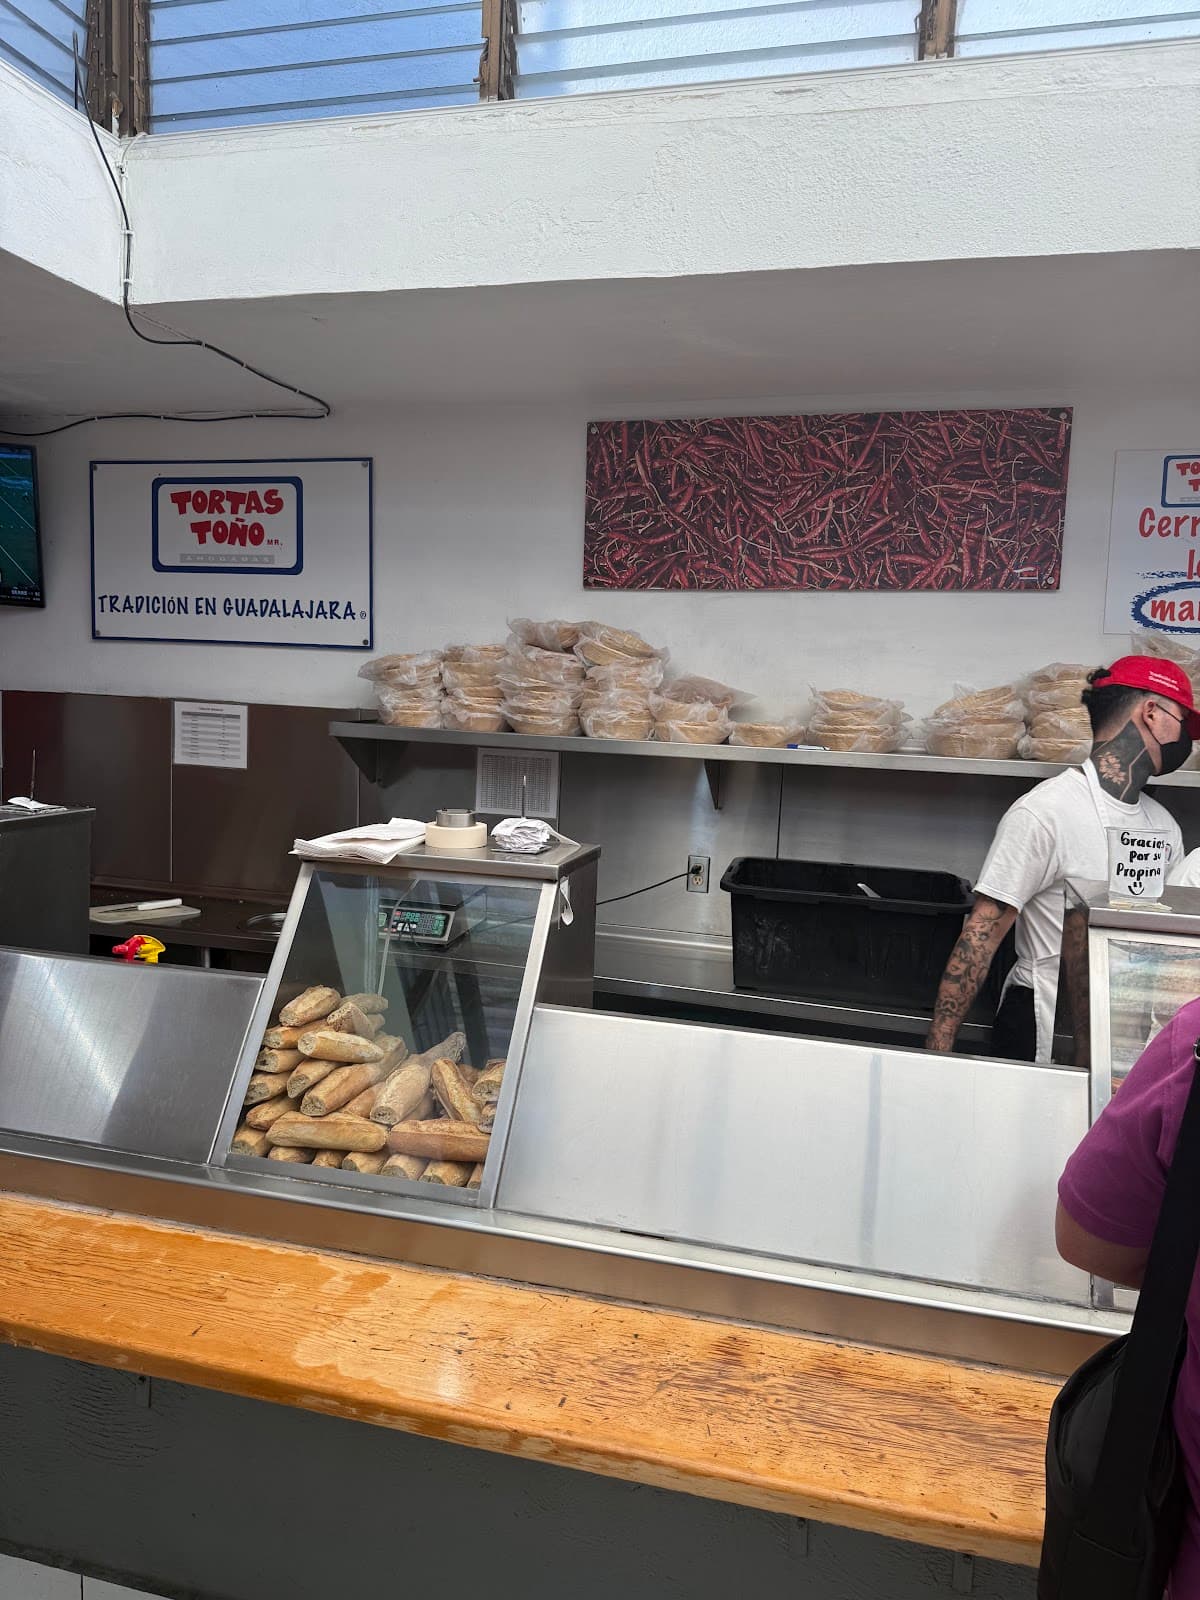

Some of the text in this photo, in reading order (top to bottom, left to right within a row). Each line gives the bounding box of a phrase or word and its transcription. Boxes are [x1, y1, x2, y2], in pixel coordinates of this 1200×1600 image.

[170, 489, 284, 515] TORTAS
[190, 518, 265, 547] TOÑO
[98, 595, 189, 615] TRADICIÓN
[195, 597, 217, 616] EN
[223, 598, 356, 620] GUADALAJARA
[1120, 832, 1165, 848] Gracias
[1116, 862, 1161, 881] Propina
